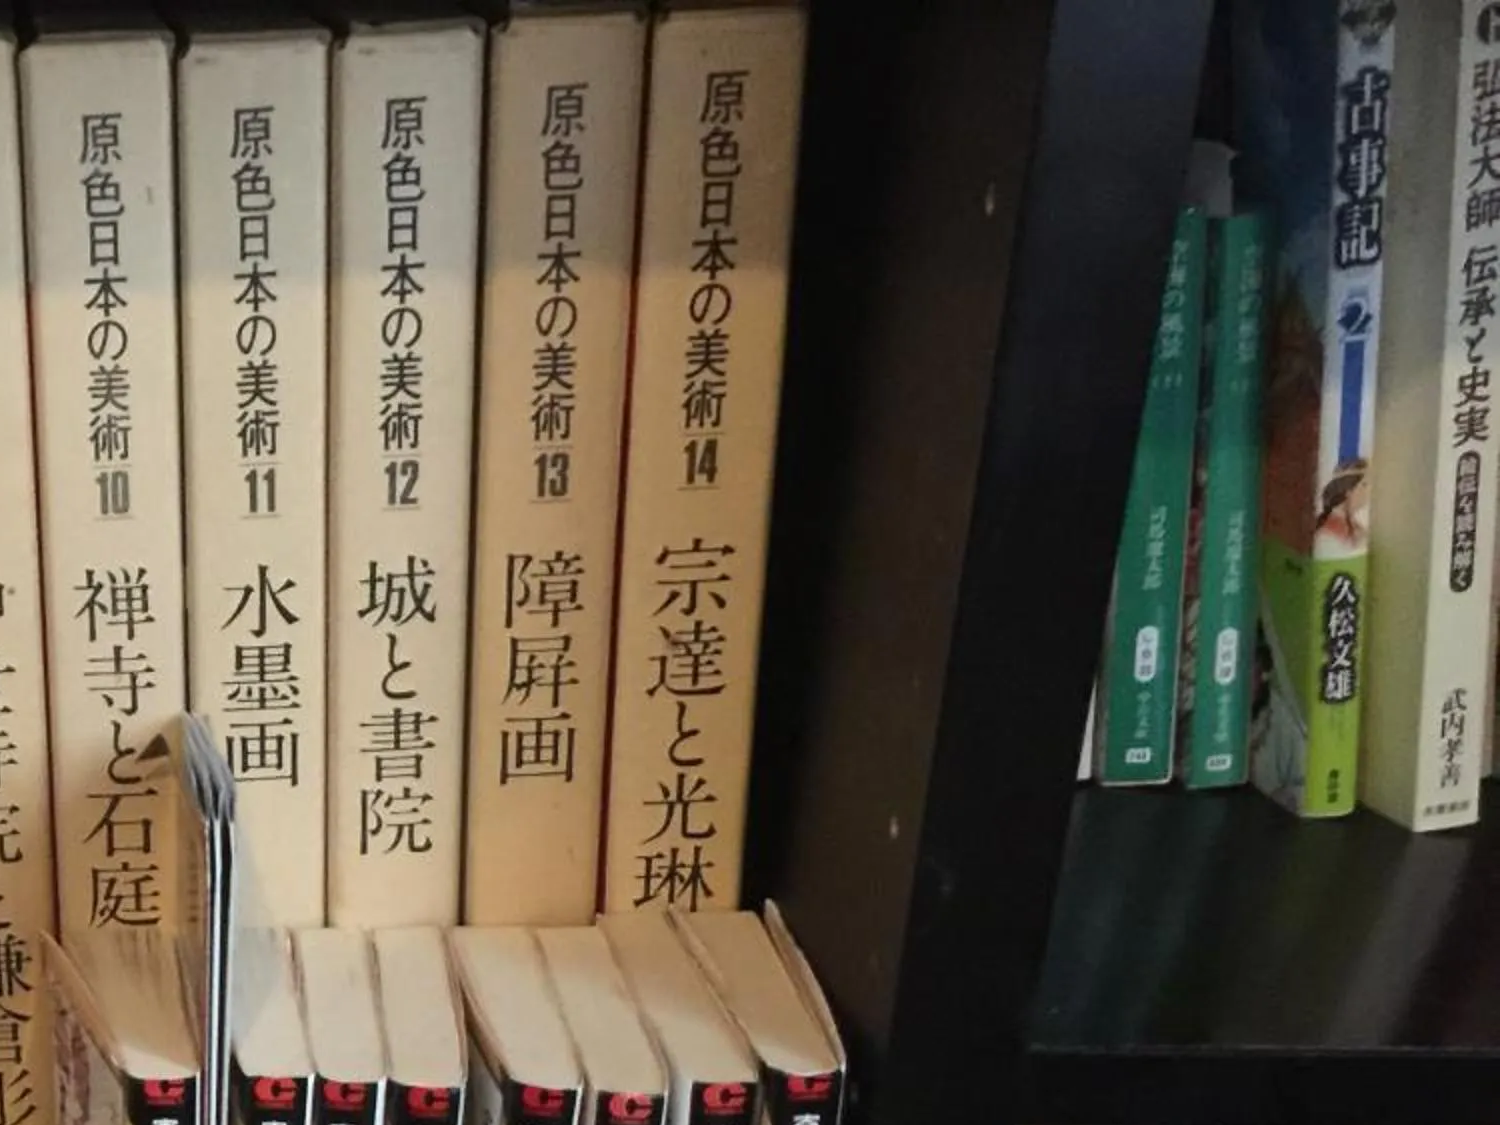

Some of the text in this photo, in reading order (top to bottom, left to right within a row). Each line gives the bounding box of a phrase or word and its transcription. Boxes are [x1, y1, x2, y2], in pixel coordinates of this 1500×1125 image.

[79, 112, 132, 514] 原色日本の美術 10
[231, 105, 280, 513] 原色日本の美術 11
[380, 96, 428, 506] 原色日本の美術 12
[531, 82, 588, 499] 原色日本の美術 13
[682, 70, 750, 486] 原色日本の美術 14
[1338, 68, 1390, 267] 古事記
[74, 567, 162, 929] 禅寺と石庭
[221, 563, 301, 787] 水墨画
[357, 555, 437, 856] 城と書院
[633, 538, 736, 914] 宗達と光琳
[1323, 574, 1357, 701] 久松文雄
